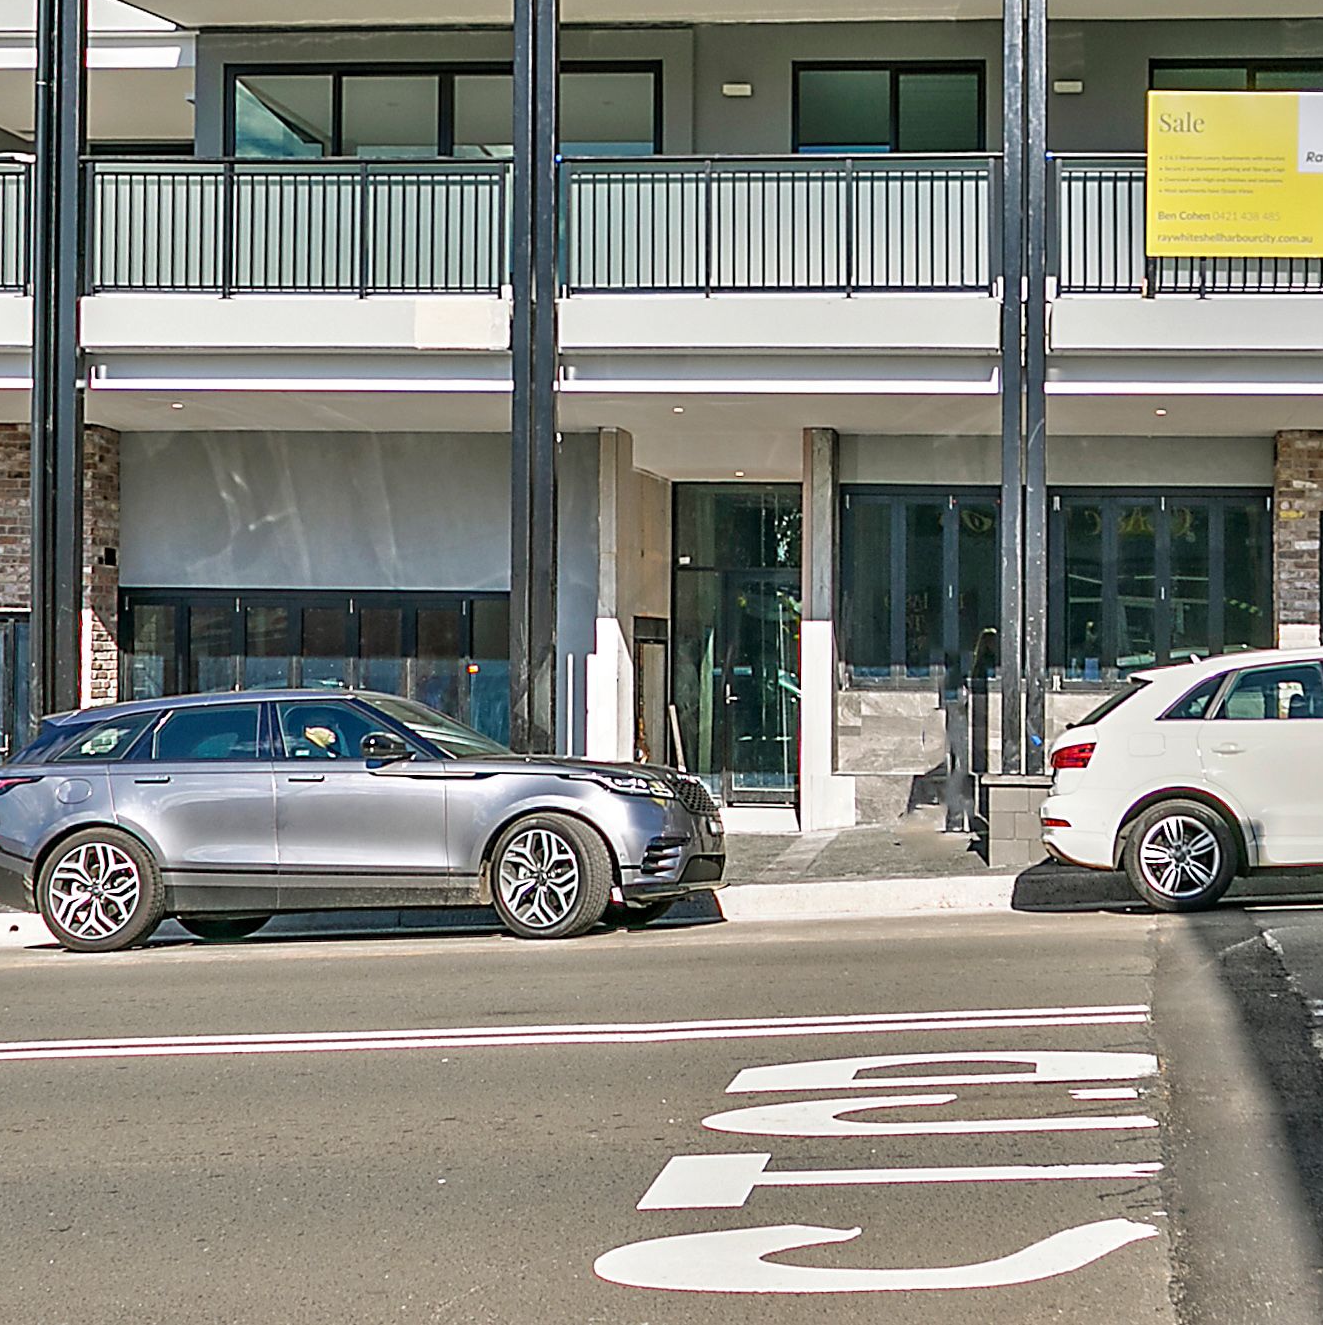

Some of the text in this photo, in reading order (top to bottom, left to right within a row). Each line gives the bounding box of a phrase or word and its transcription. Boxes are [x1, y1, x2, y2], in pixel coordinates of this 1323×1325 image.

[1158, 111, 1206, 134] Sale
[1157, 211, 1177, 221] Ben
[1178, 211, 1211, 221] Cohen
